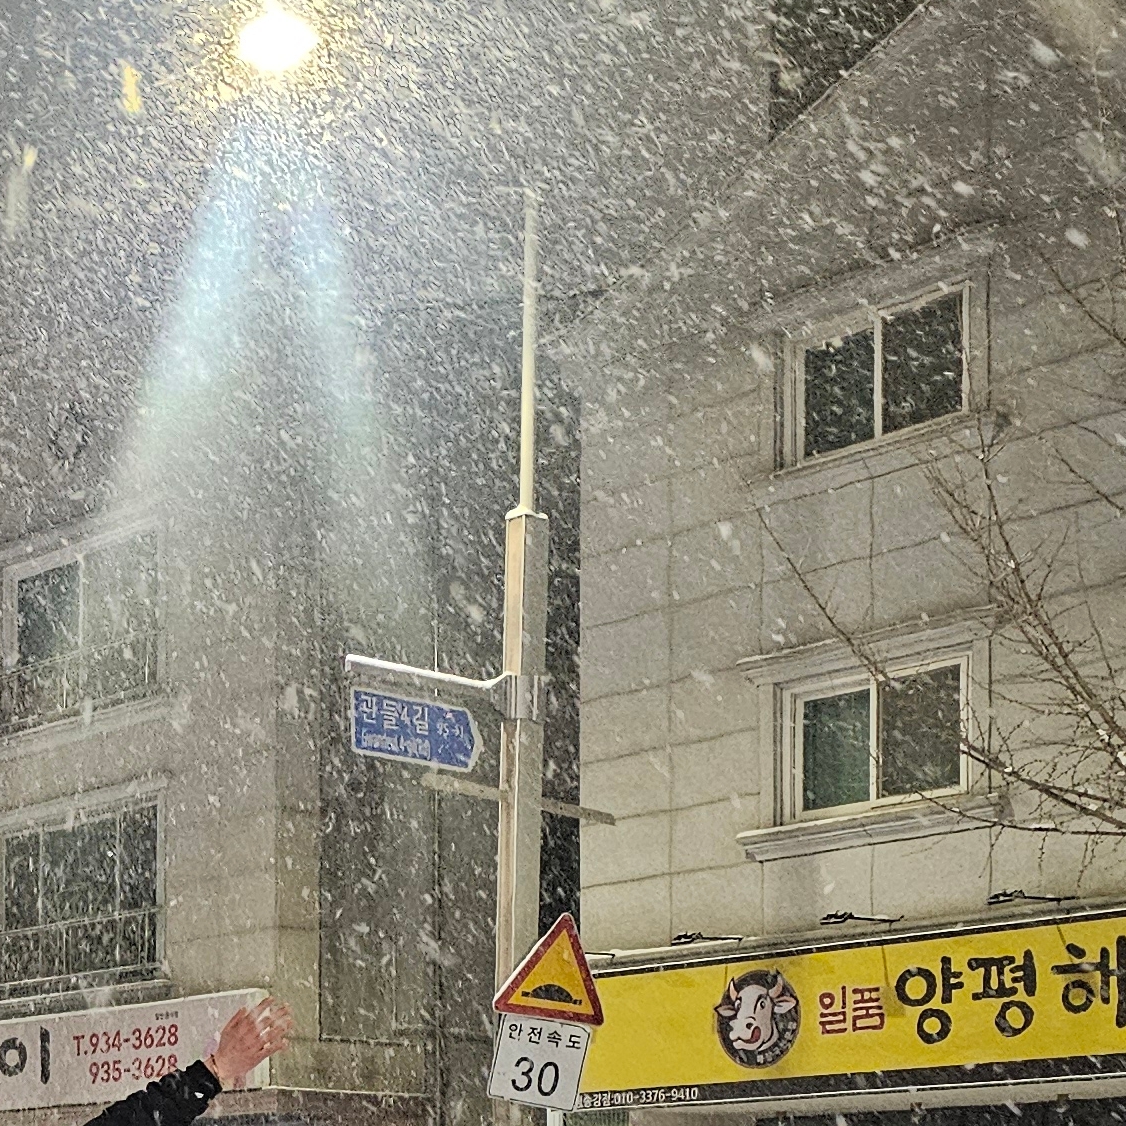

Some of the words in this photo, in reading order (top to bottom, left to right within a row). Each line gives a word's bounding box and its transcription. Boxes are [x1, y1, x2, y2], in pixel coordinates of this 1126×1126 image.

[818, 985, 886, 1036] 일품
[73, 1023, 179, 1056] T.934-3628
[508, 1023, 582, 1050] 안전속도
[88, 1053, 178, 1085] 935-3628
[511, 1056, 560, 1097] 30
